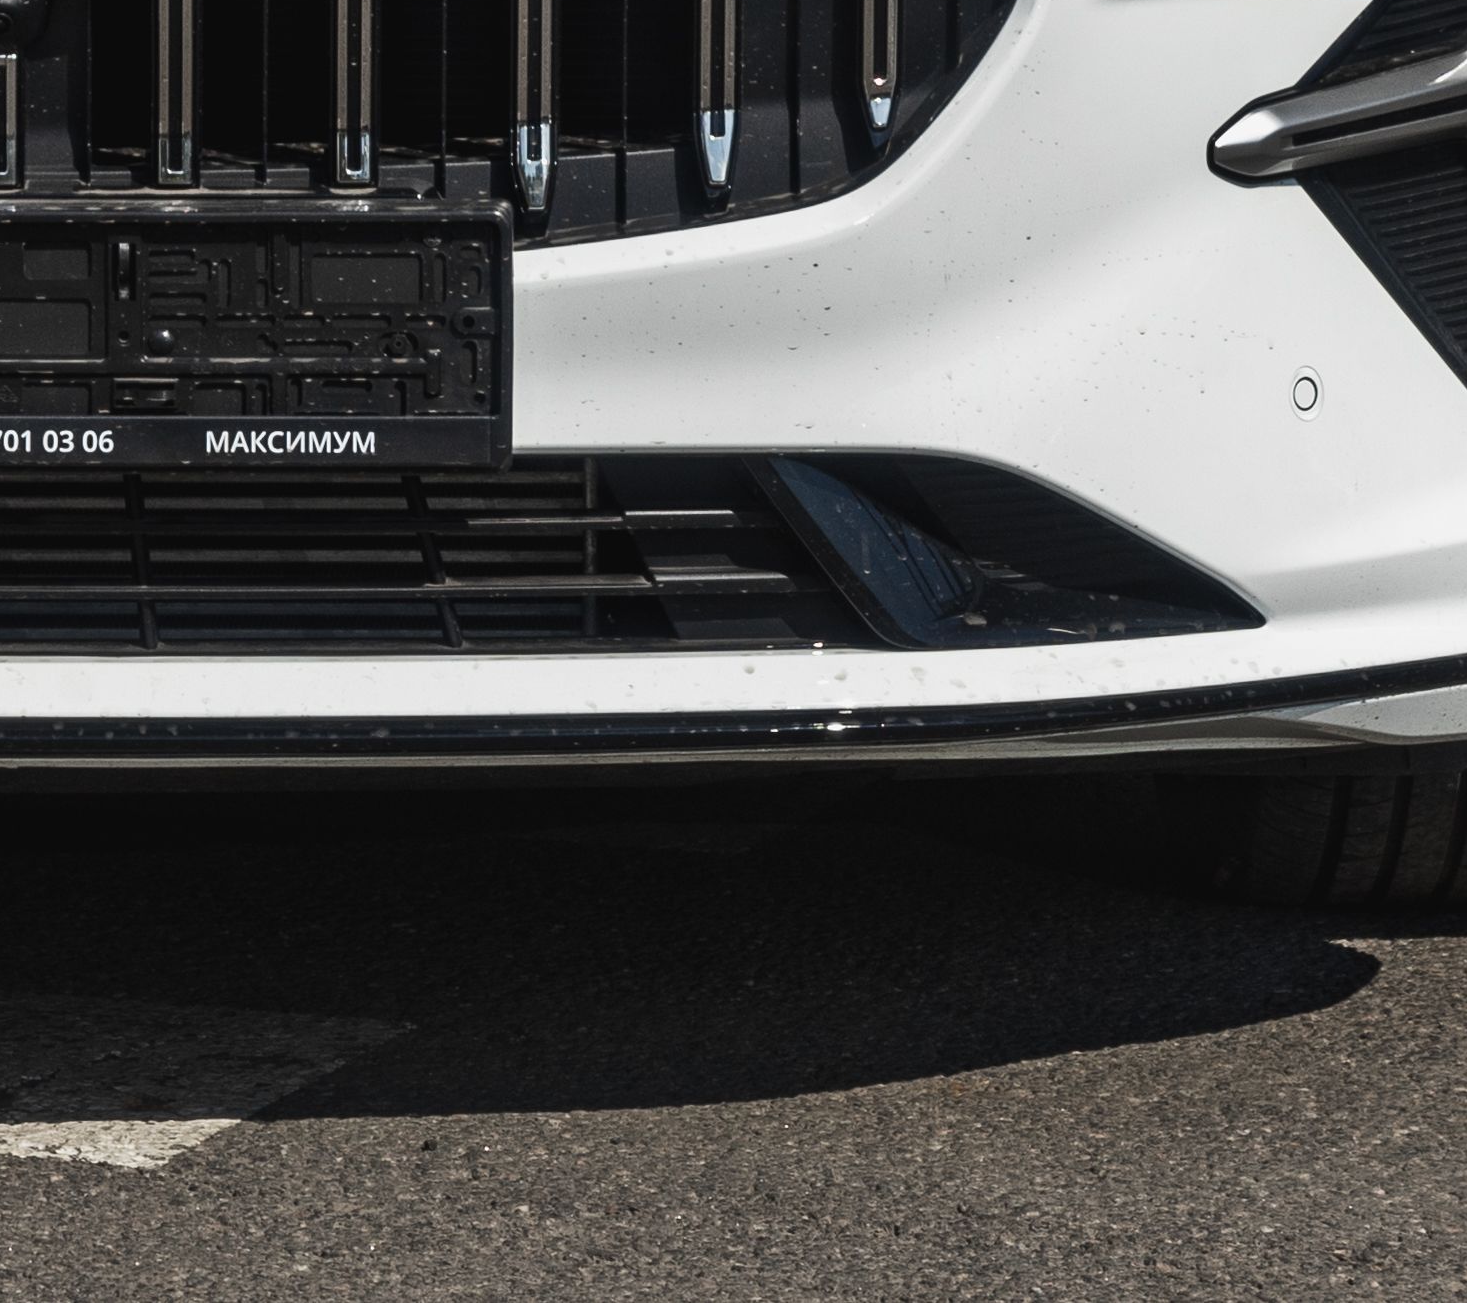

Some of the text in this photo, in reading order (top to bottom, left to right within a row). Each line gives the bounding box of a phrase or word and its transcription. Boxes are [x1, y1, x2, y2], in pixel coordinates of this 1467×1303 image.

[42, 428, 76, 454] 03
[82, 428, 116, 454] 06
[205, 429, 377, 455] МАКСИМУМ
